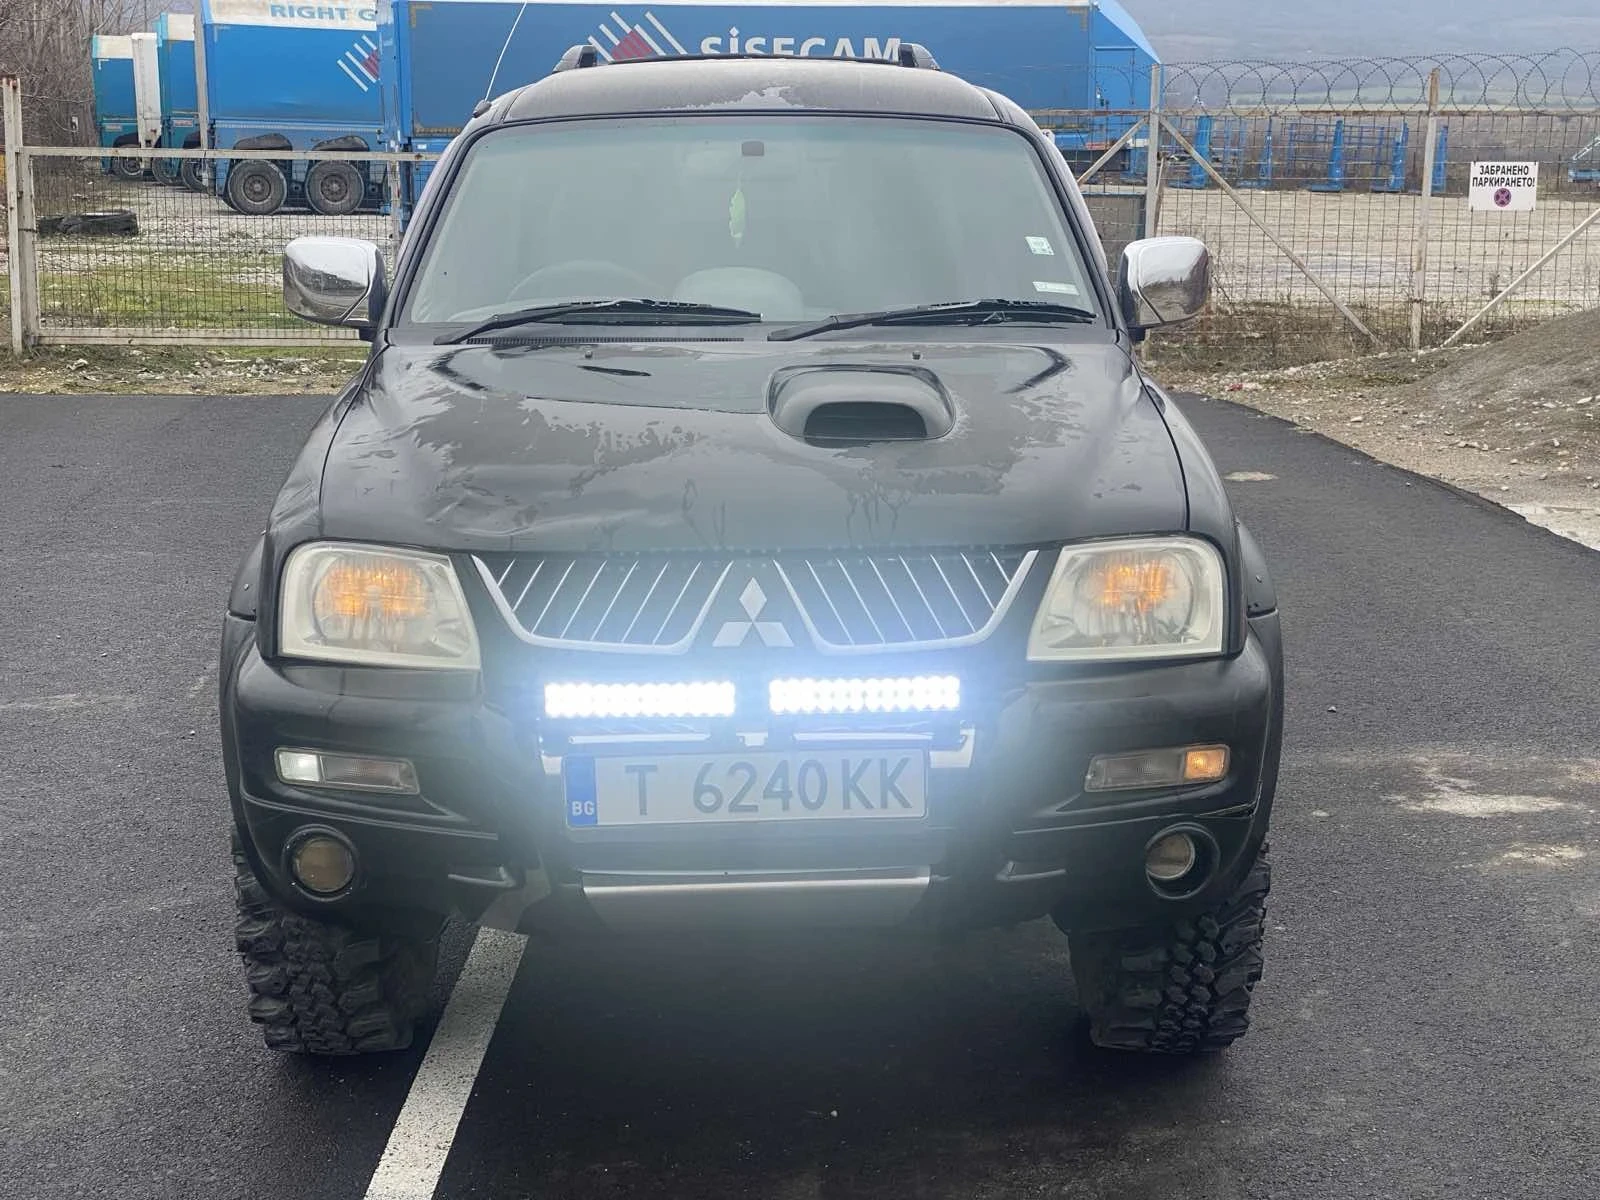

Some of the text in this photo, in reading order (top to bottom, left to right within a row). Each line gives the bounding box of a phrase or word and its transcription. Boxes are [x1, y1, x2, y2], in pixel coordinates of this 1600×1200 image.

[270, 4, 349, 20] RIGHT
[1479, 165, 1529, 175] ЗАБРАНЕНО
[1472, 177, 1535, 187] ПАРКИРАНЕТО!
[625, 757, 913, 816] T 6240 KK
[571, 800, 595, 816] BG
